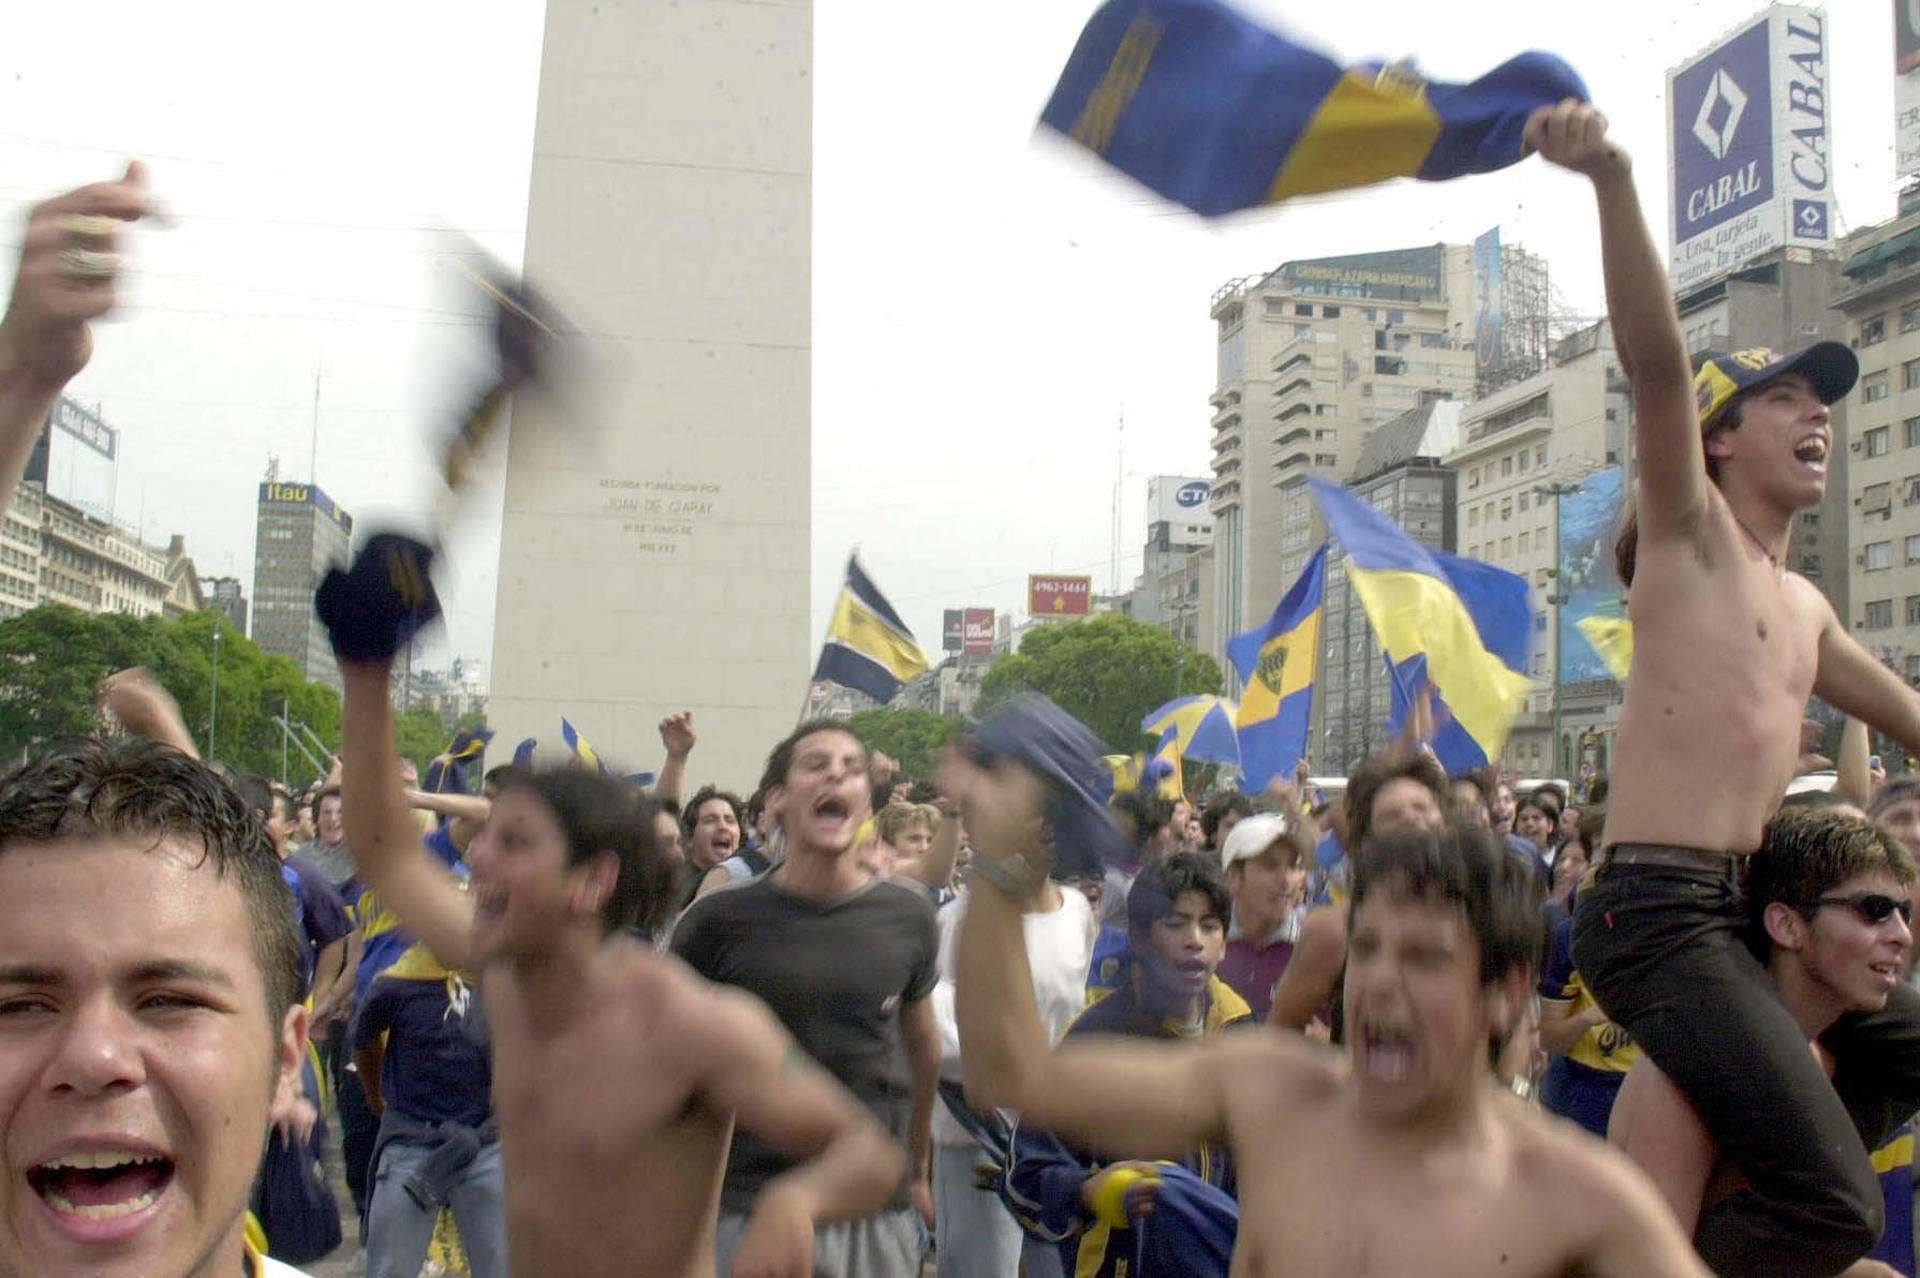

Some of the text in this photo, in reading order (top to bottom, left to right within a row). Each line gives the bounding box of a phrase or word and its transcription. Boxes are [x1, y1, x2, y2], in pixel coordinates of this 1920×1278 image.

[1787, 13, 1828, 191] CABAL
[1688, 159, 1760, 222] CABAL
[1686, 238, 1712, 259] Una
